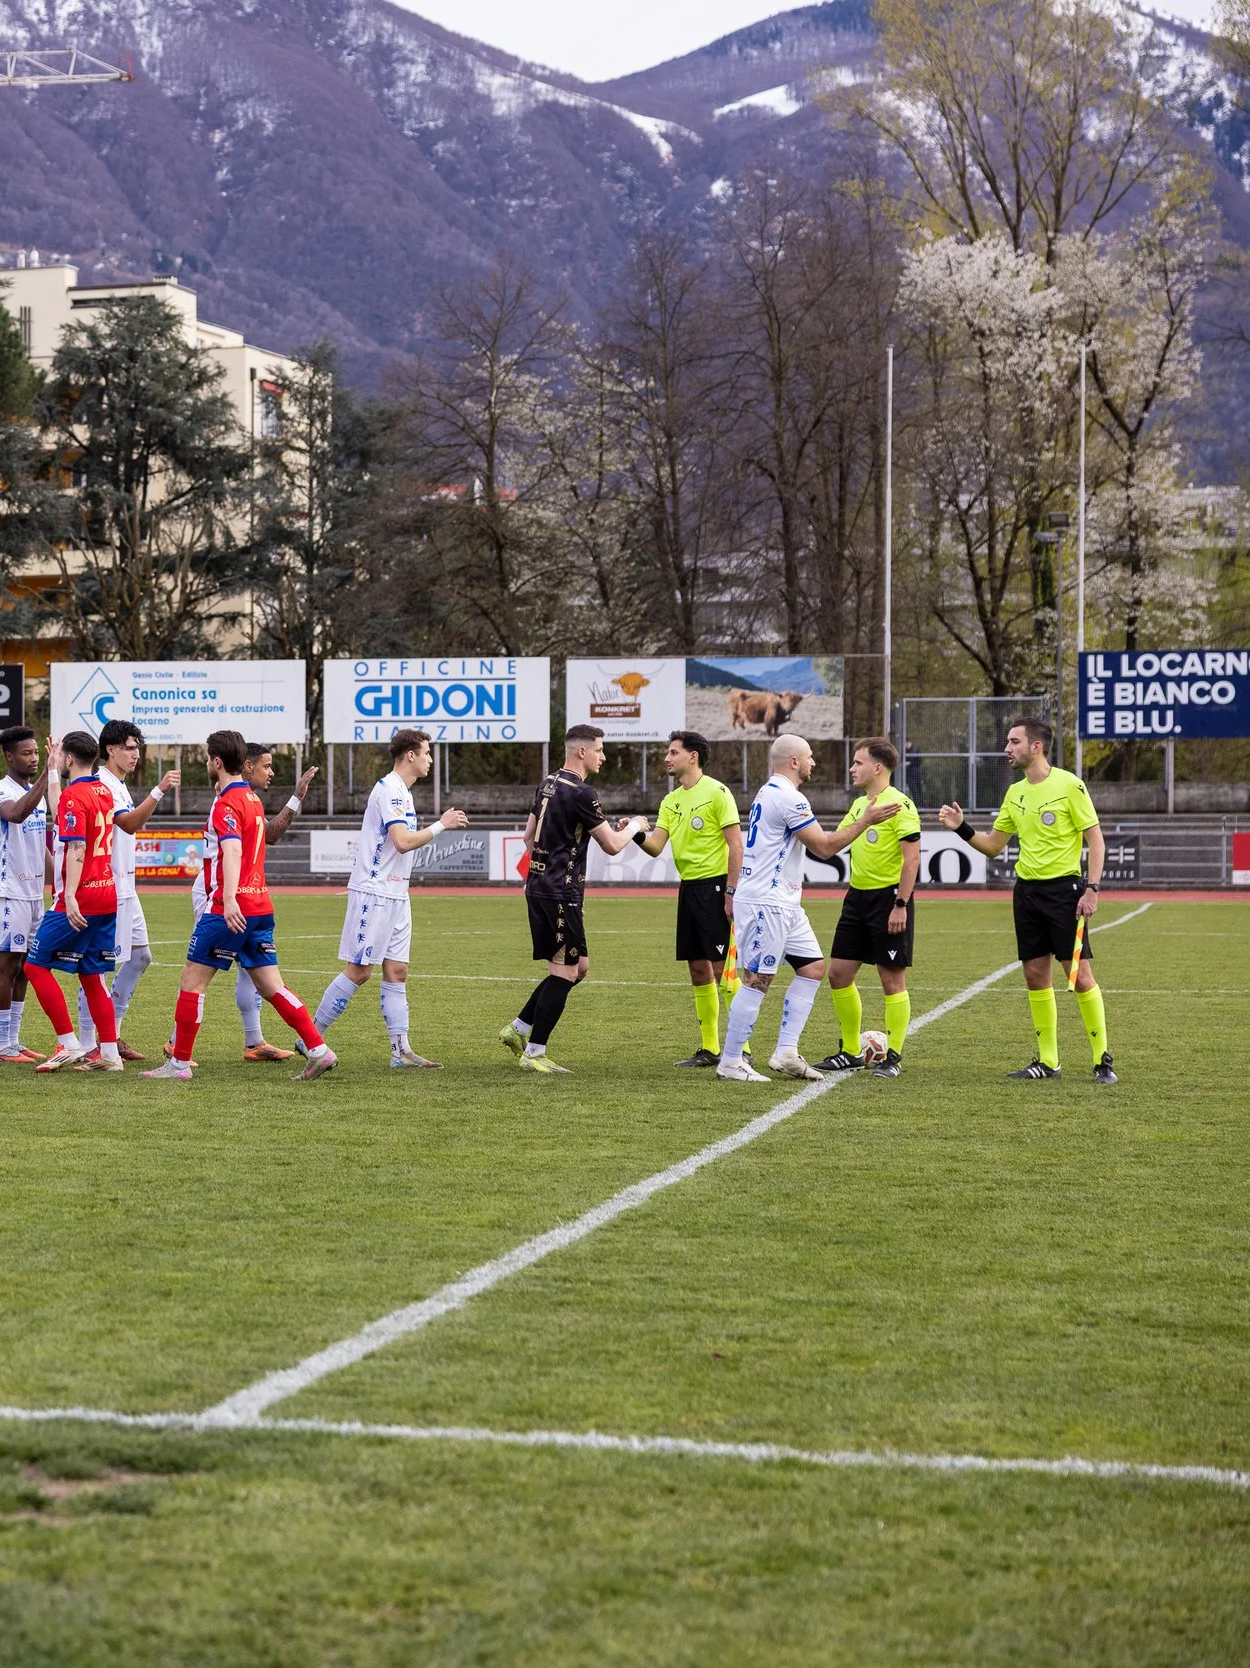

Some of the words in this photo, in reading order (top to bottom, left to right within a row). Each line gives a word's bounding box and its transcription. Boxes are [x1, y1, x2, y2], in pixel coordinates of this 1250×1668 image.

[354, 660, 517, 677] OFFICINE
[1087, 654, 1112, 678] IL
[1121, 652, 1250, 678] LOCARN
[132, 687, 196, 700] Canonica
[202, 689, 217, 700] sa
[354, 684, 517, 717] GHIDONI
[1087, 677, 1106, 706] È
[1114, 680, 1236, 706] BIANCO
[132, 704, 170, 715] Impresa
[173, 704, 215, 716] generale
[219, 703, 227, 713] di
[230, 702, 284, 713] costruzione
[132, 716, 170, 725] Locarno
[1087, 710, 1106, 734] E
[1113, 710, 1183, 734] BLU.
